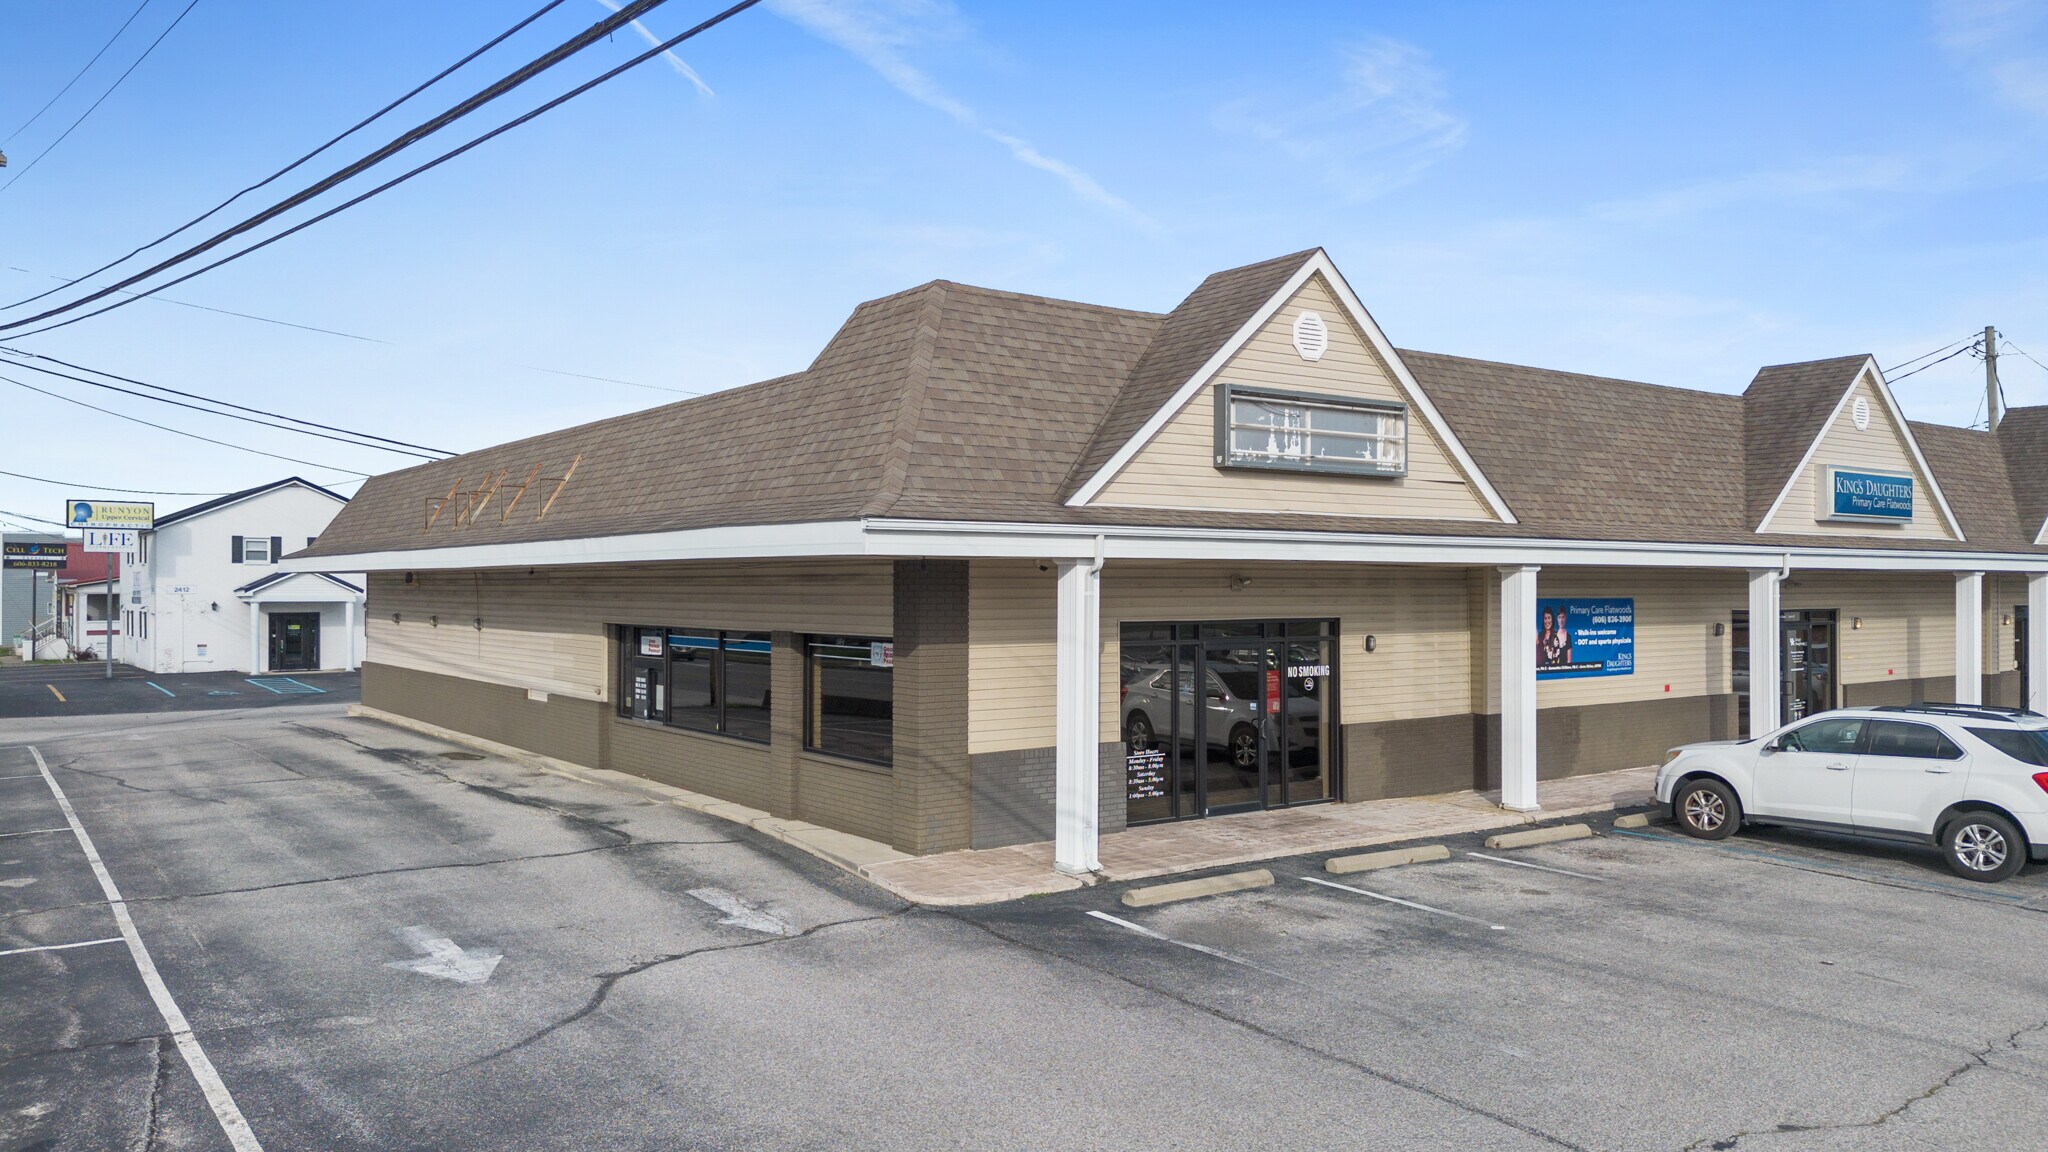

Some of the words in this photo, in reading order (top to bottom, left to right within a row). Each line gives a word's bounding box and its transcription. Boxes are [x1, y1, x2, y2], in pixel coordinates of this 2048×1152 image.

[1865, 479, 1912, 499] DAUGHTERS
[1852, 495, 1873, 510] Primary
[1873, 497, 1886, 509] Care
[1886, 498, 1912, 511] Flatwoods
[101, 506, 150, 514] RUNYON
[1570, 605, 1590, 616] Primary
[1590, 605, 1604, 614] Care
[1604, 604, 1632, 614] Flatwoods
[1592, 615, 1607, 625] (606)
[1597, 628, 1617, 636] welcome
[1287, 666, 1298, 678] NO
[1298, 665, 1330, 677] SMOKING
